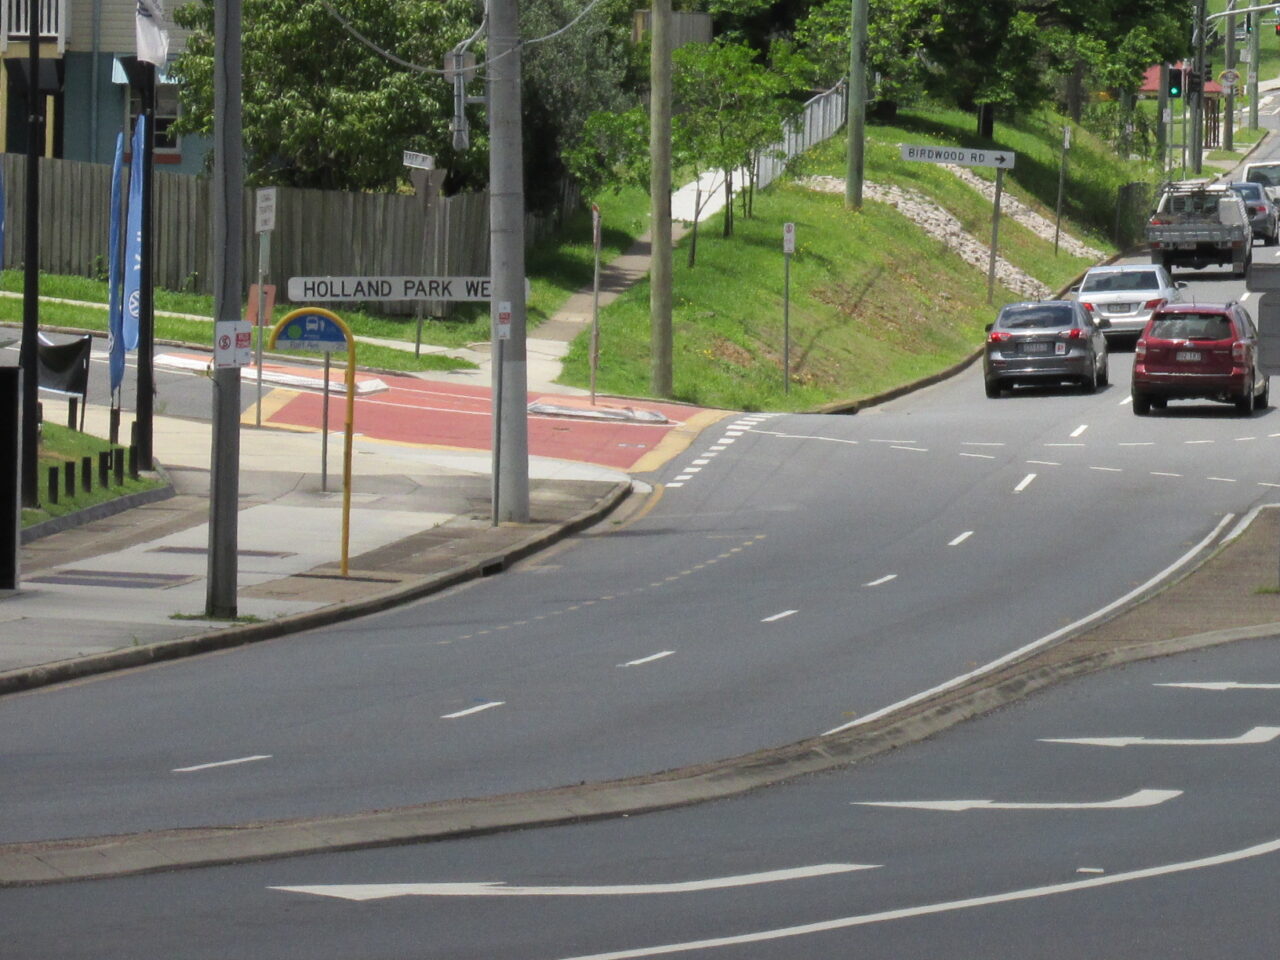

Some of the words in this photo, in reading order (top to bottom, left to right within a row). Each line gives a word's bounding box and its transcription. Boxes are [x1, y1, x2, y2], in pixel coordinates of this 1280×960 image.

[908, 147, 965, 161] BIRDWOOD
[970, 152, 985, 162] RD
[303, 280, 393, 298] HOLLAND
[403, 279, 453, 297] PARK
[465, 280, 491, 297] WE
